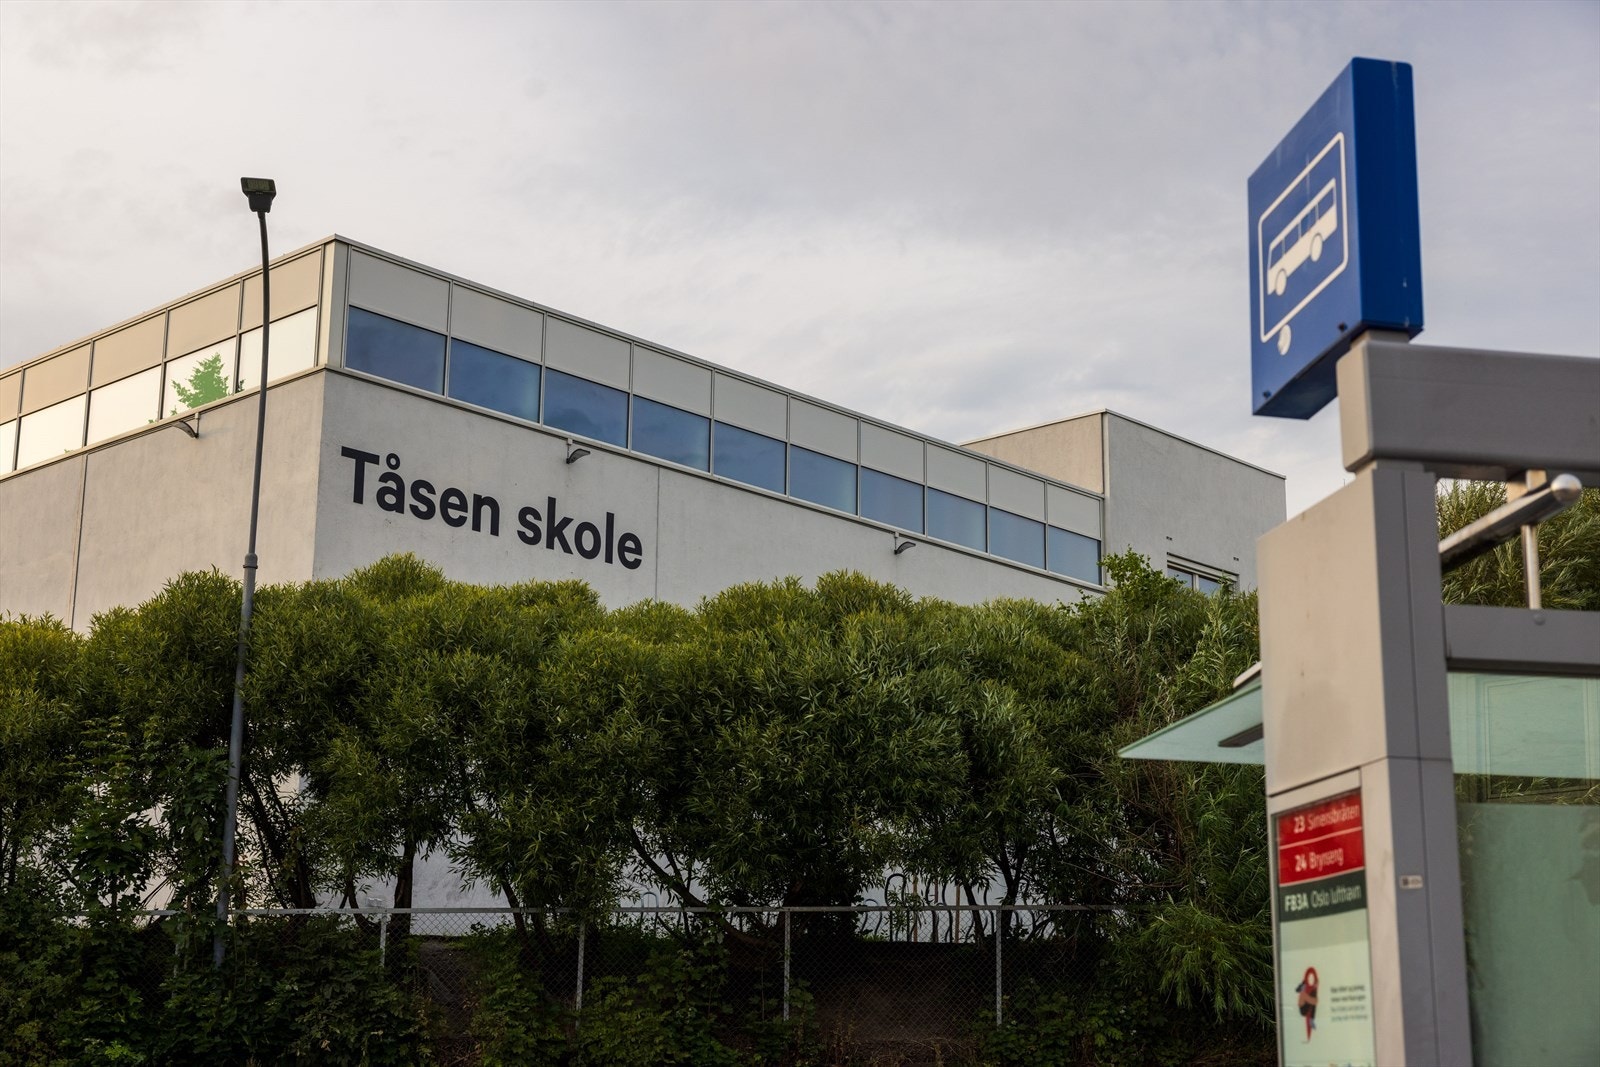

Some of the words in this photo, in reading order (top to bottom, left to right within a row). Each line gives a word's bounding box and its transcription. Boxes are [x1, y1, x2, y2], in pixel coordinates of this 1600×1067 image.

[341, 446, 500, 537] Tåsen
[516, 496, 643, 570] skole
[1293, 815, 1306, 834] 23
[1295, 854, 1307, 872] 24
[1310, 848, 1344, 871] Brynseng
[1311, 890, 1330, 908] Oslo
[1331, 885, 1361, 904] lufthavn
